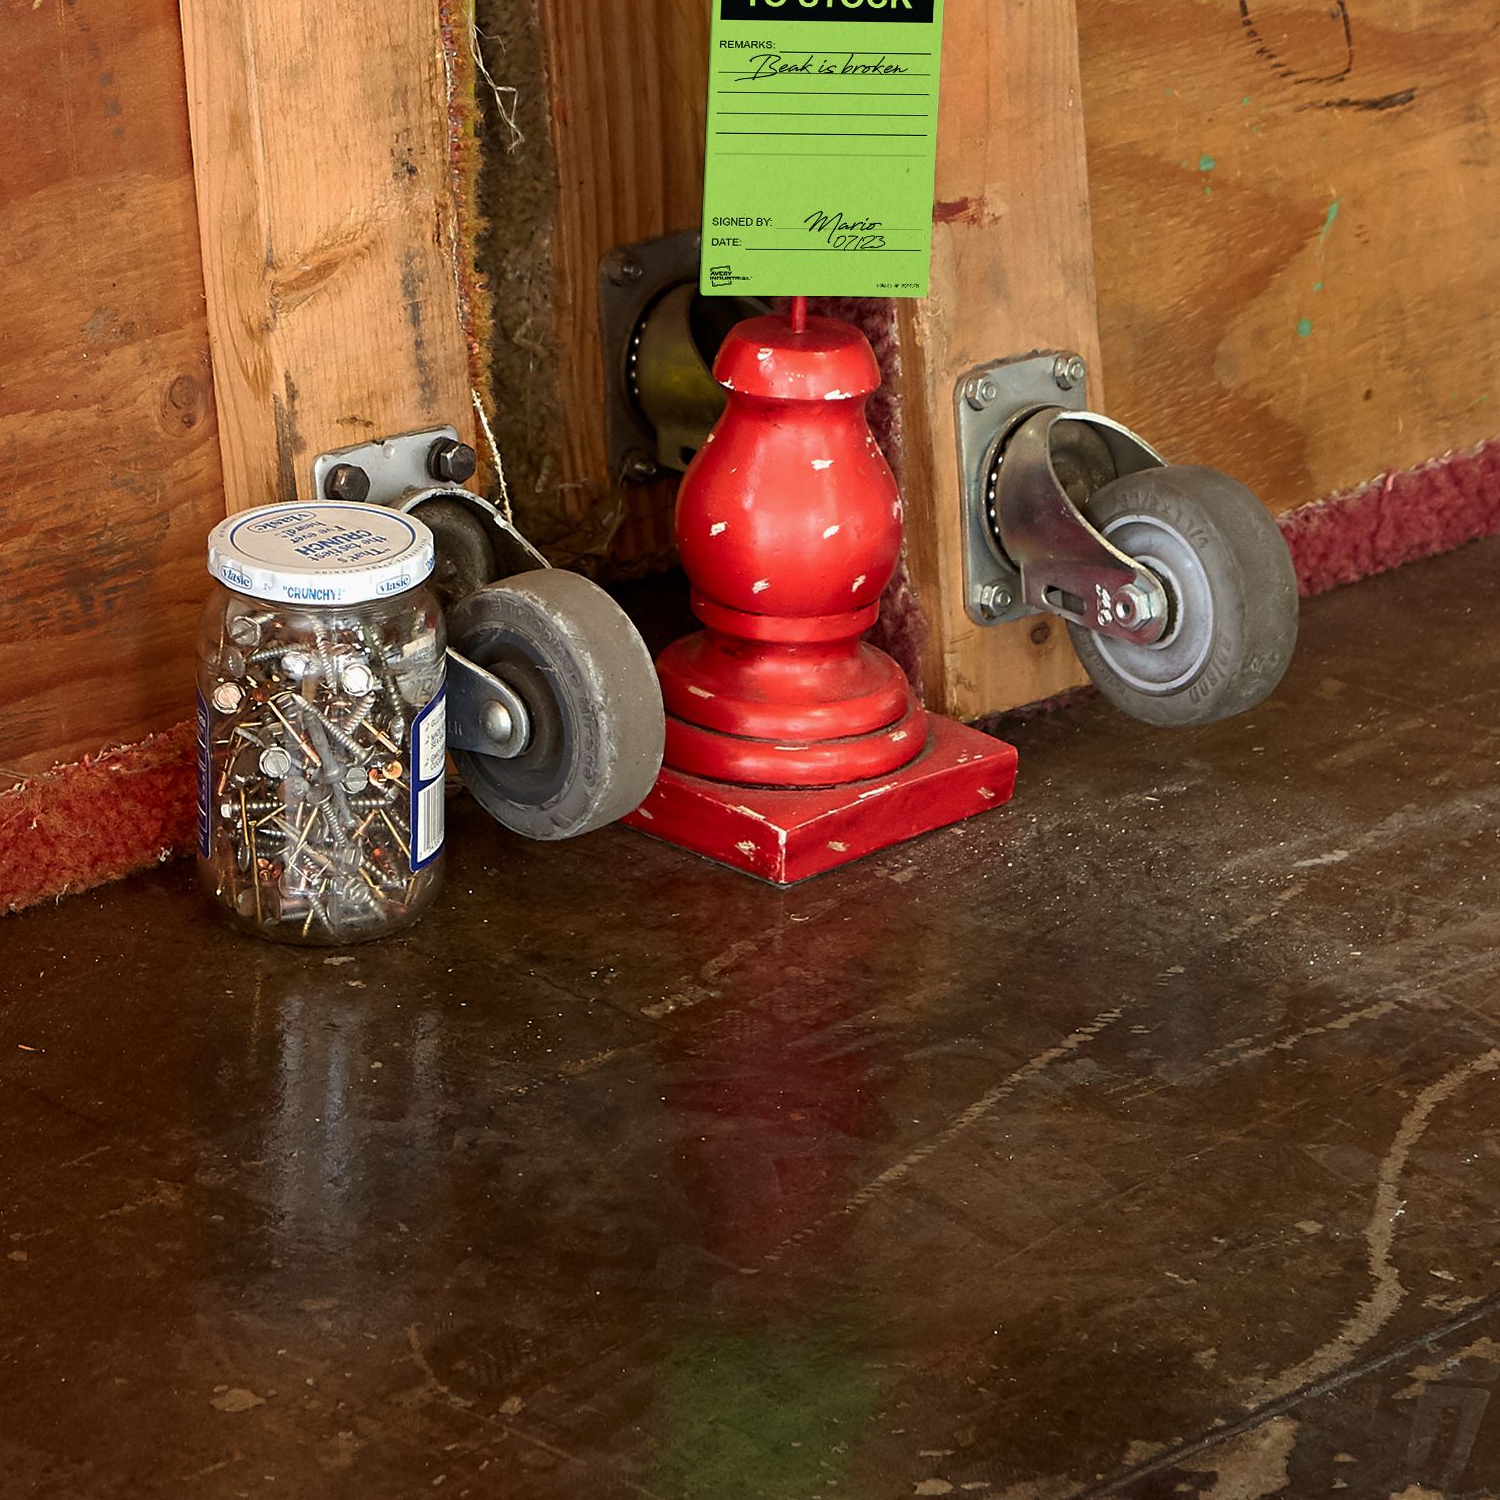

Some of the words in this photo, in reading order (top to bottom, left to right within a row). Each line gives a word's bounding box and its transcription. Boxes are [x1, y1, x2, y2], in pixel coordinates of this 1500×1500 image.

[719, 40, 776, 50] REMARKS:
[733, 53, 815, 82] Beak
[817, 59, 837, 75] is
[840, 52, 909, 76] broken
[711, 217, 754, 228] SIGNED
[755, 217, 773, 228] BY:
[803, 210, 883, 244] Mario
[711, 238, 742, 248] DATE:
[832, 234, 887, 252] 07/23
[289, 530, 317, 545] ever
[294, 529, 373, 557] CRUNCH
[359, 535, 388, 547] the
[308, 541, 359, 563] tastiest
